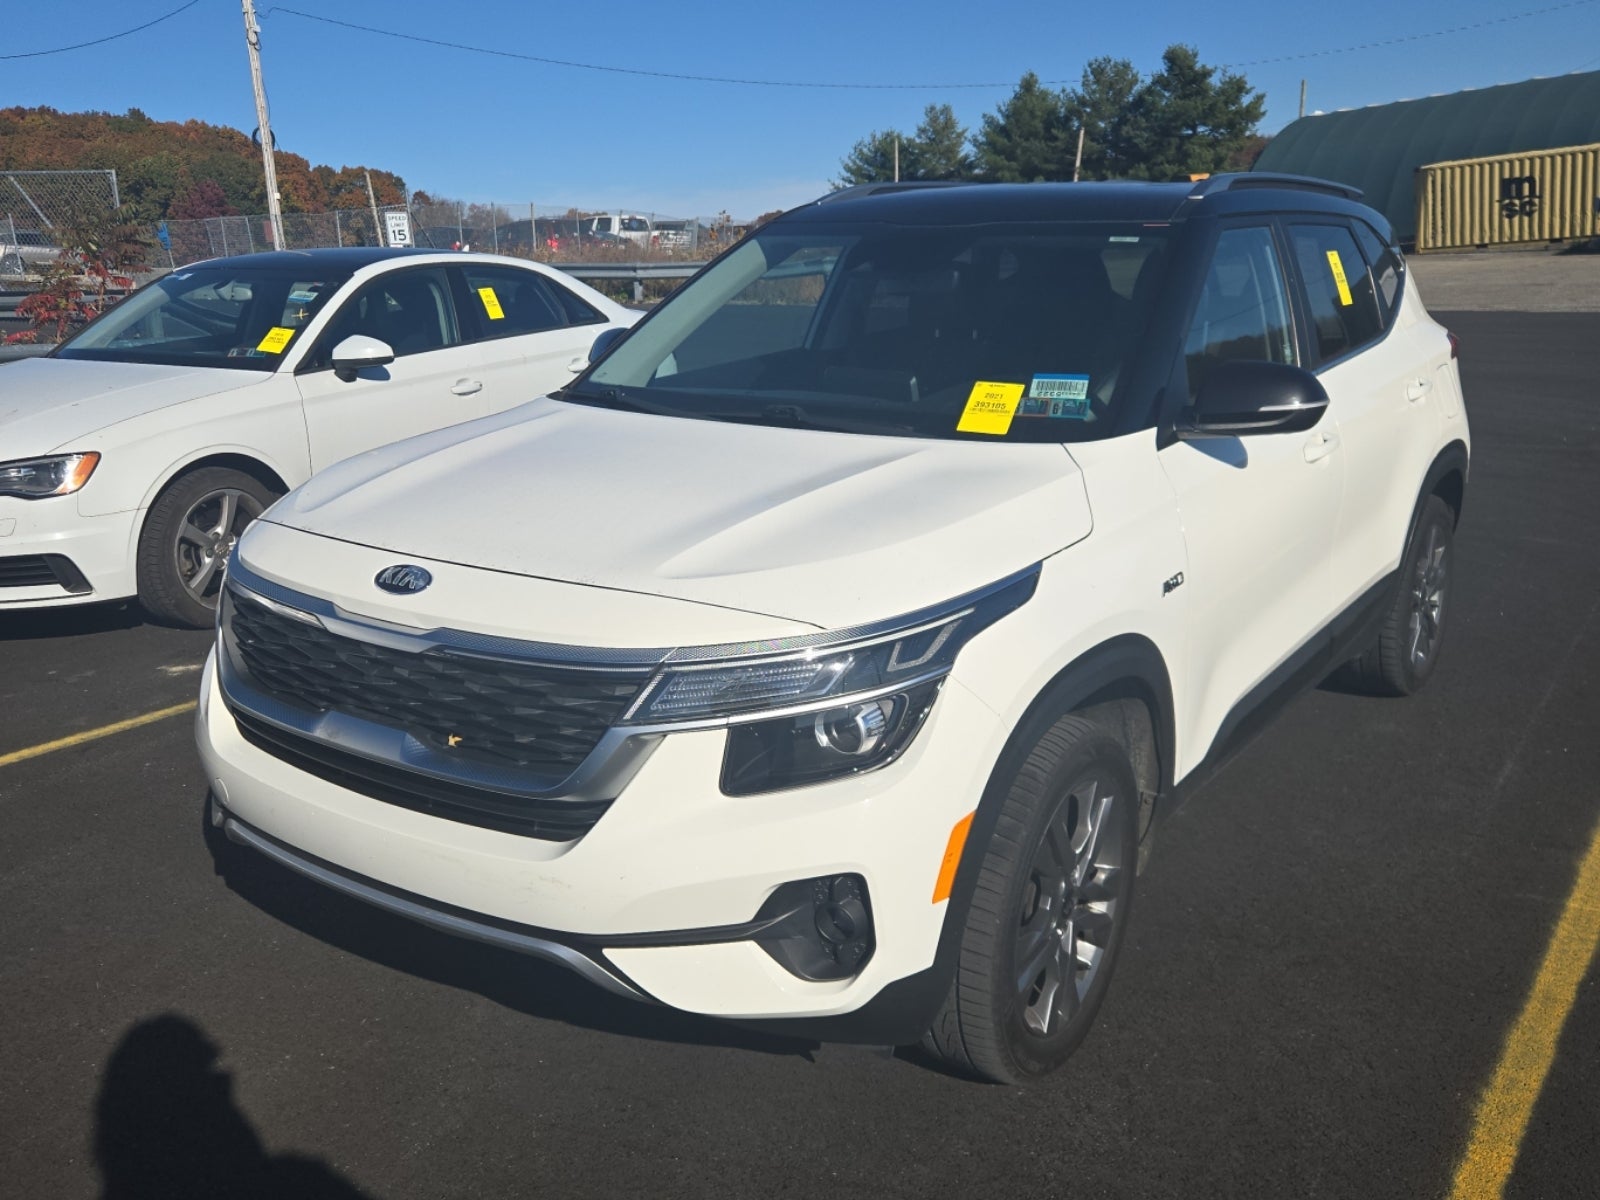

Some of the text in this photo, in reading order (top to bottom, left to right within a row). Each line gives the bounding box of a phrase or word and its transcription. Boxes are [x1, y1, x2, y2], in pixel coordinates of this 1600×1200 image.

[392, 229, 407, 241] 15
[984, 392, 1004, 400] 2021
[974, 400, 1007, 410] 393105
[378, 566, 422, 590] KIA
